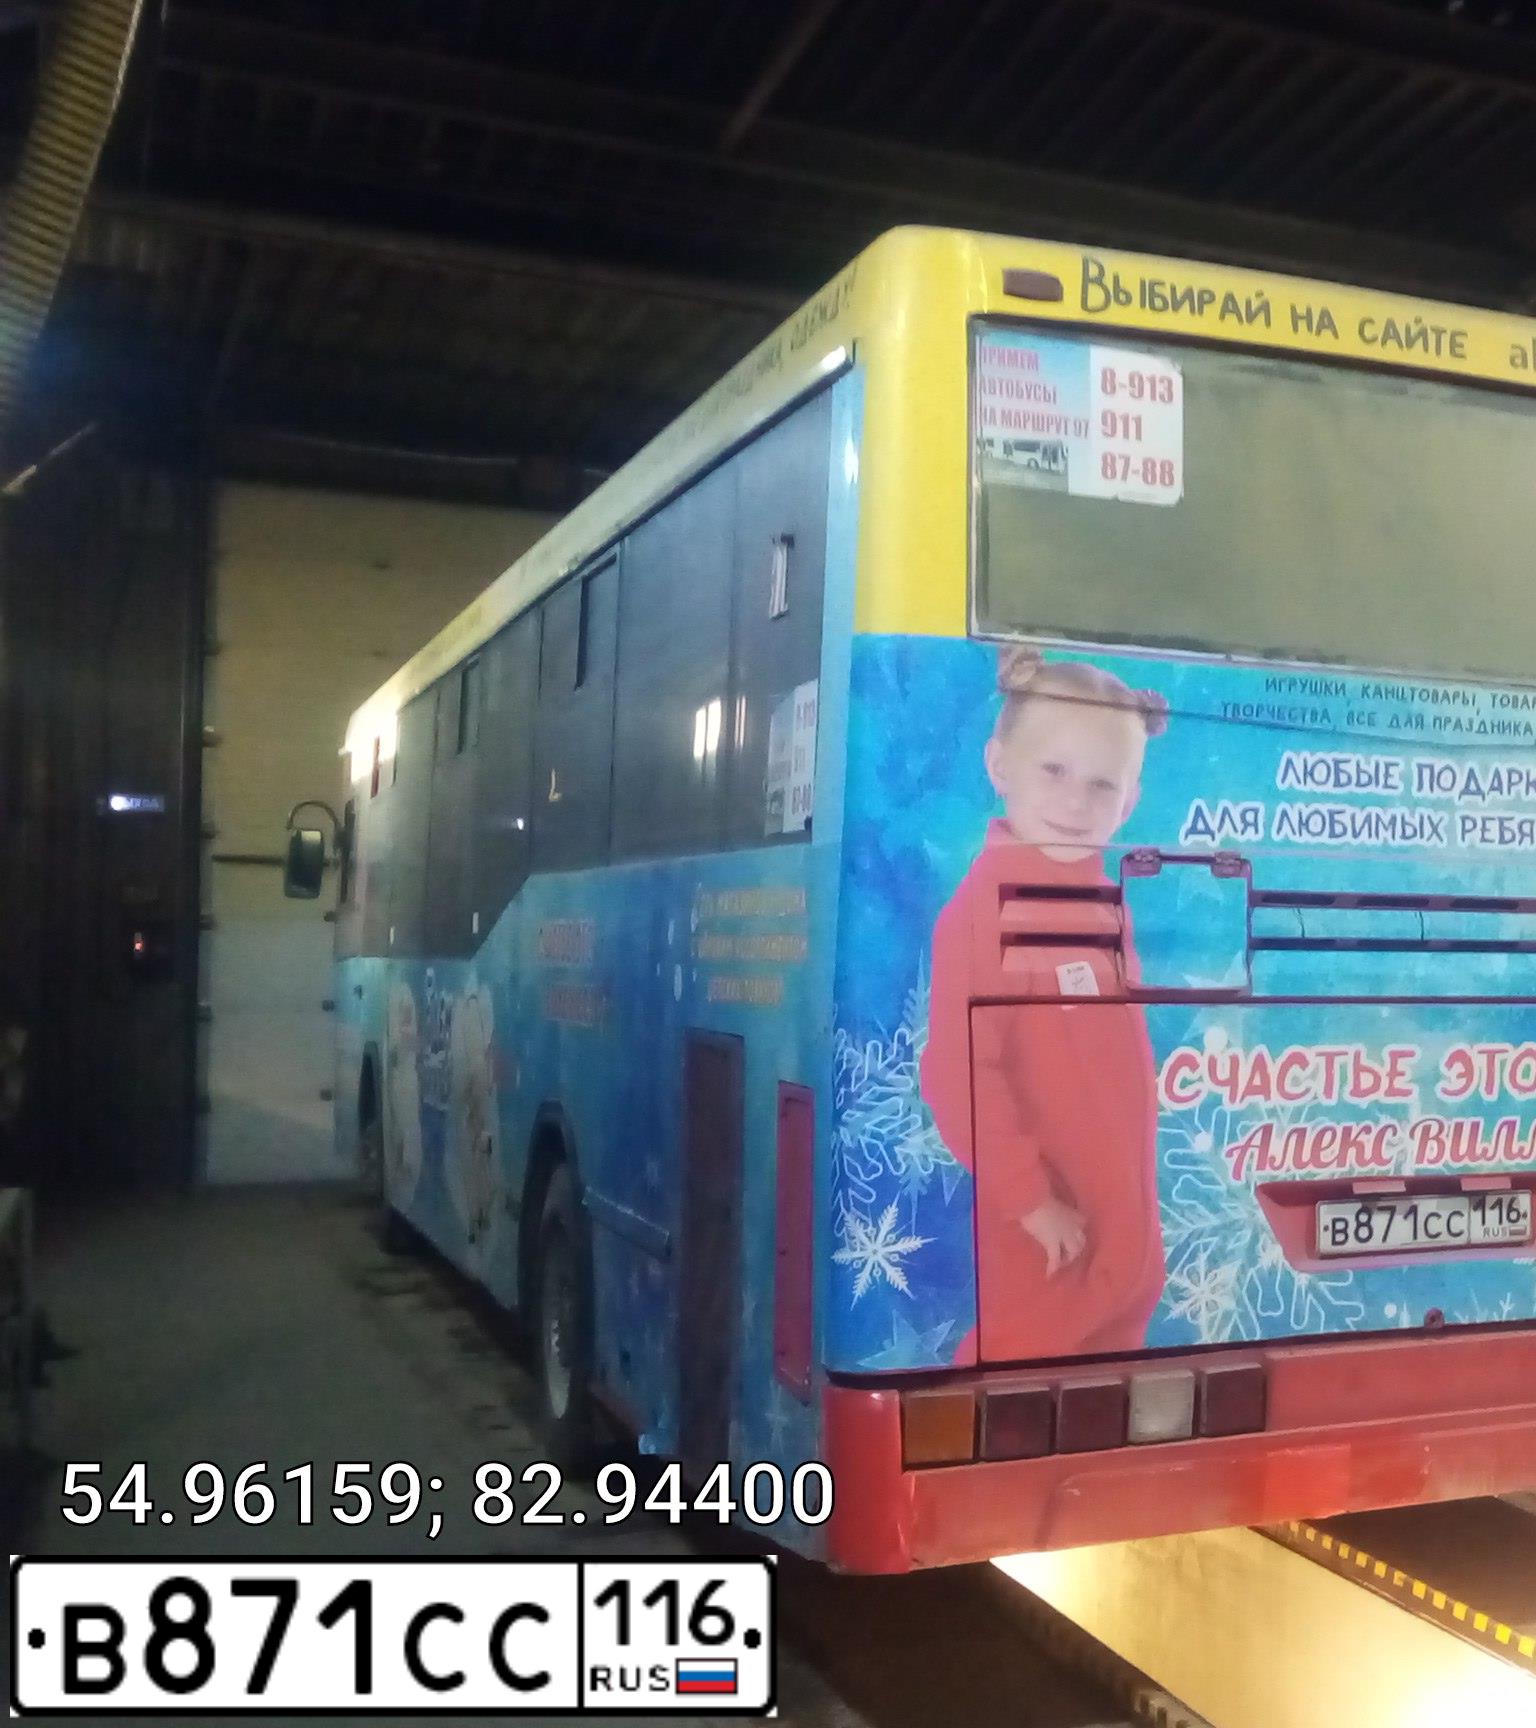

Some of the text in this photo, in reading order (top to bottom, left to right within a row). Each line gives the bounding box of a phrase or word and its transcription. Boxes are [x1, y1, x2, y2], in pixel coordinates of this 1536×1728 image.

[1291, 305, 1339, 340] НА
[1358, 316, 1469, 360] САЙТЕ
[1101, 367, 1174, 404] 8-913
[1000, 409, 1071, 437] МАРШРУТ
[1101, 409, 1143, 441] 911
[1101, 452, 1175, 487] 87-88
[1346, 711, 1377, 726] ВСЕ
[1388, 711, 1425, 730] ДЛЯ
[1282, 755, 1401, 792] ЛЮБЫЕ
[1184, 804, 1260, 841] ДЛЯ
[1276, 807, 1444, 844] ЛЮБИМЫХ
[1164, 1049, 1415, 1104] СЧАСТЬЕ
[1472, 1195, 1521, 1226] 116
[1482, 1226, 1508, 1237] RUS
